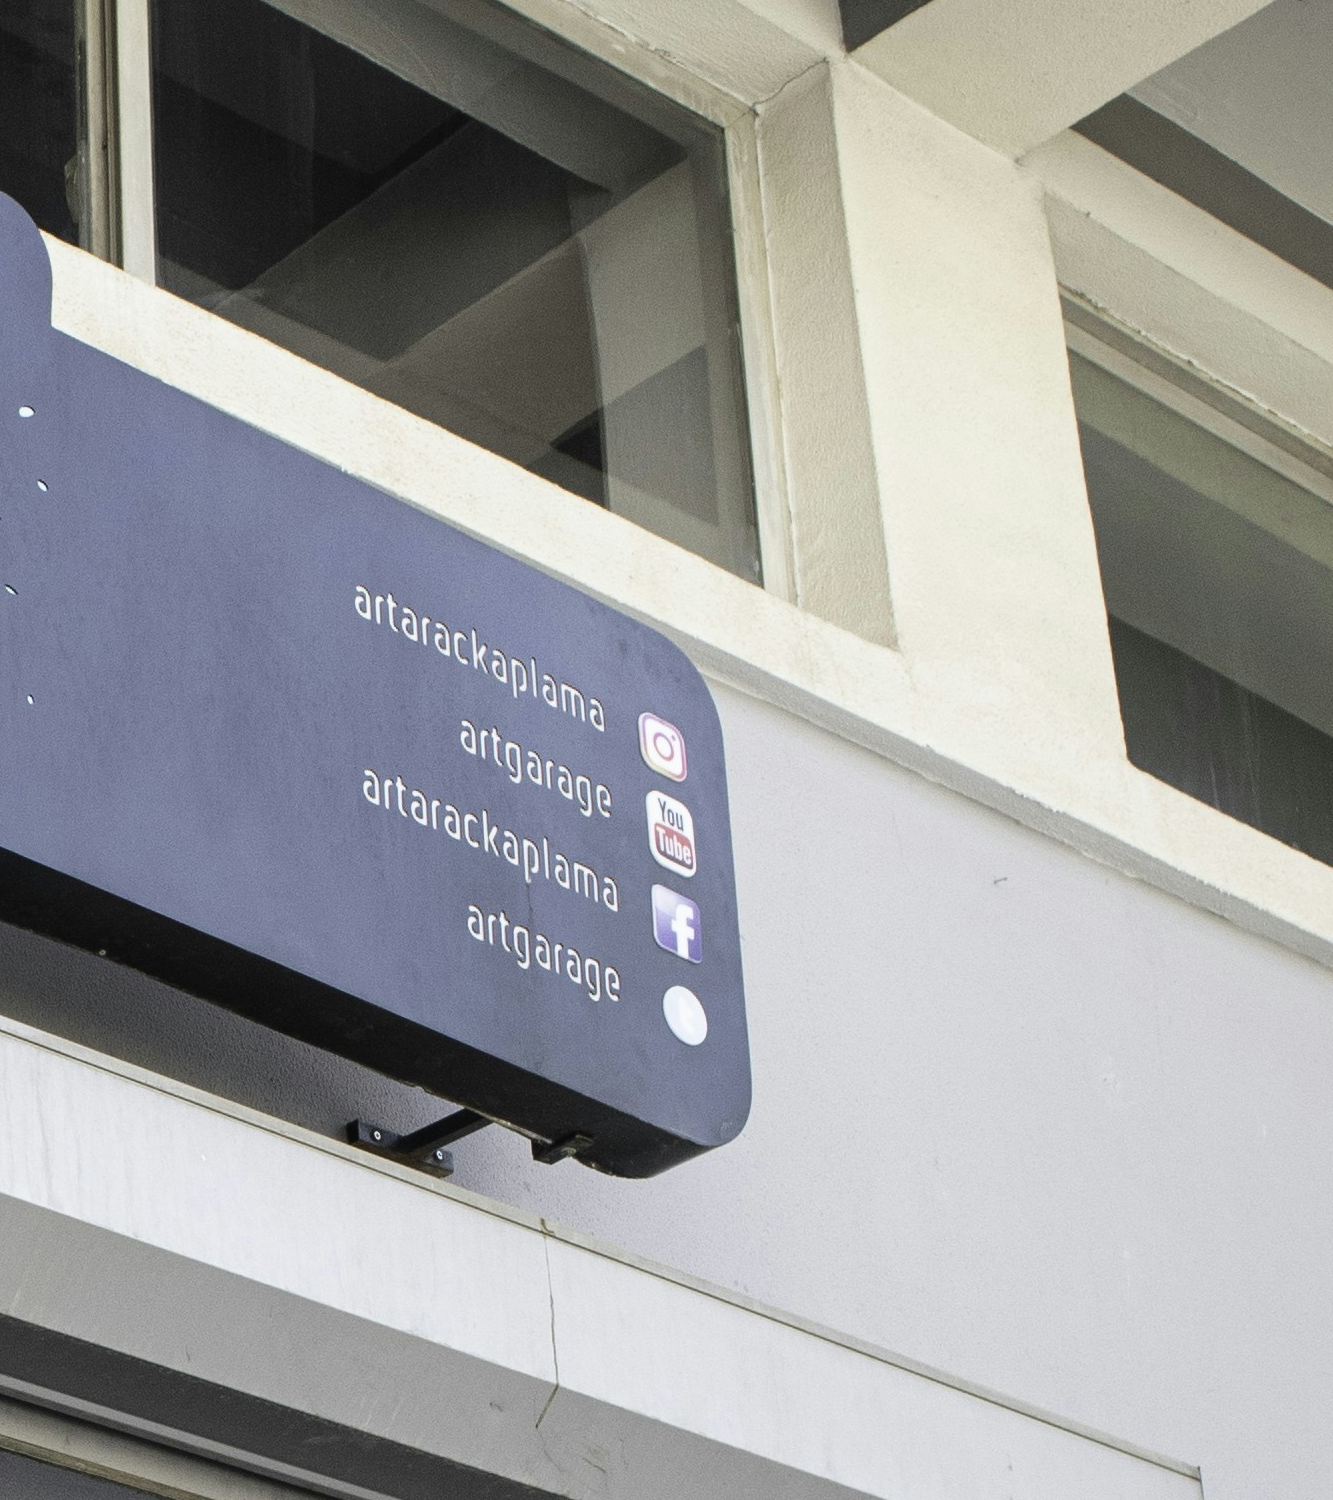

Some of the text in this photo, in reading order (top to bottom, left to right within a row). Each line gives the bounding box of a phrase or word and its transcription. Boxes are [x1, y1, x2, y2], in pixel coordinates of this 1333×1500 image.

[355, 585, 605, 732] artarackaplama
[461, 719, 612, 818] artgarage
[657, 797, 684, 832] You
[363, 769, 619, 912] artarackaplama
[656, 827, 692, 866] Tube
[467, 904, 621, 1001] artgarage
